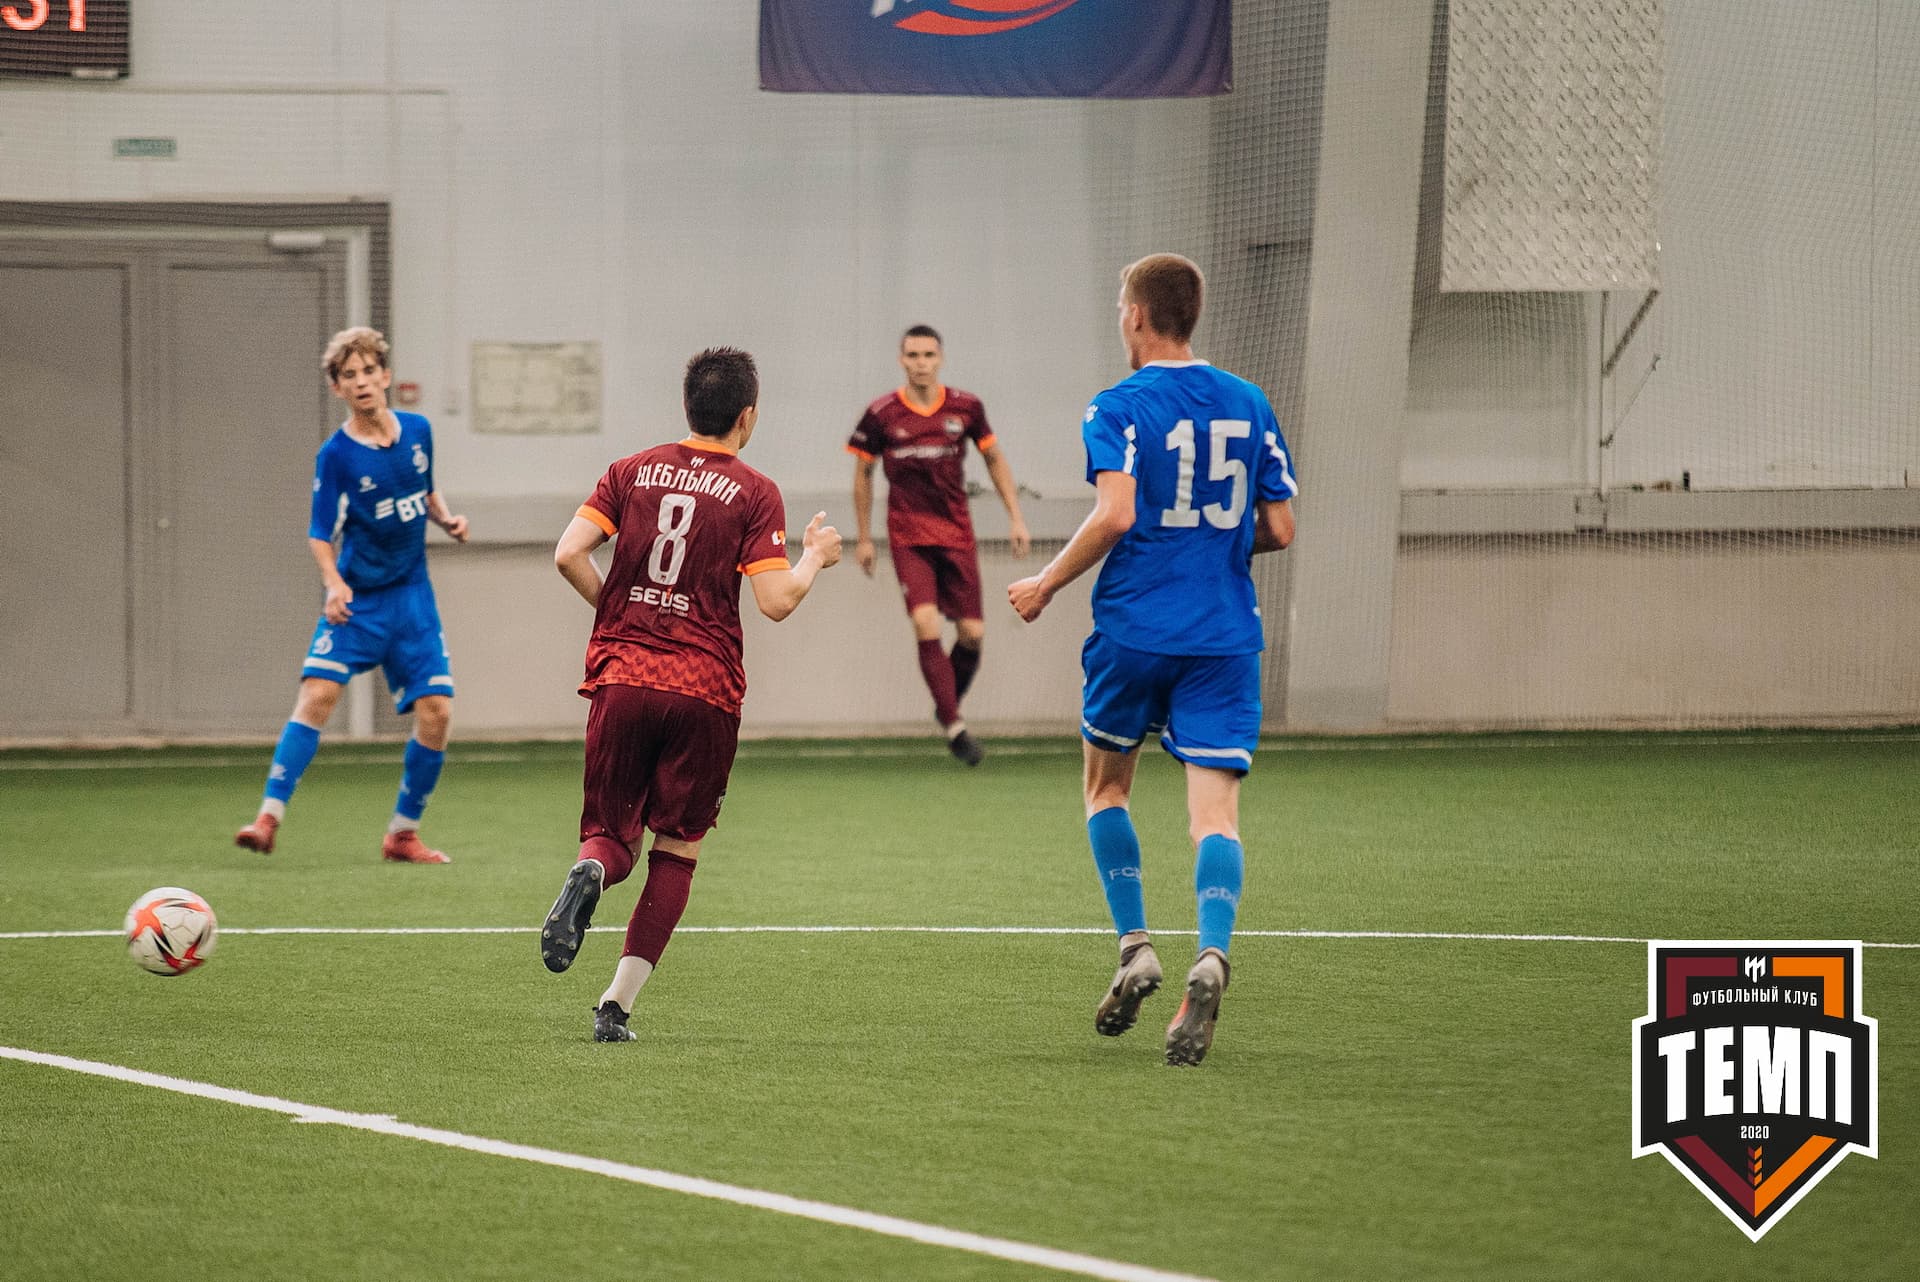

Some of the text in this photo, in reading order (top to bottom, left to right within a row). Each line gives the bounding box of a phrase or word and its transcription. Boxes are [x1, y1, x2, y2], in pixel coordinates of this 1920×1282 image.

[634, 463, 741, 505] ЩЕБЛЫКИН
[1160, 419, 1251, 530] 15
[648, 493, 697, 585] 8
[629, 586, 690, 611] SEUS
